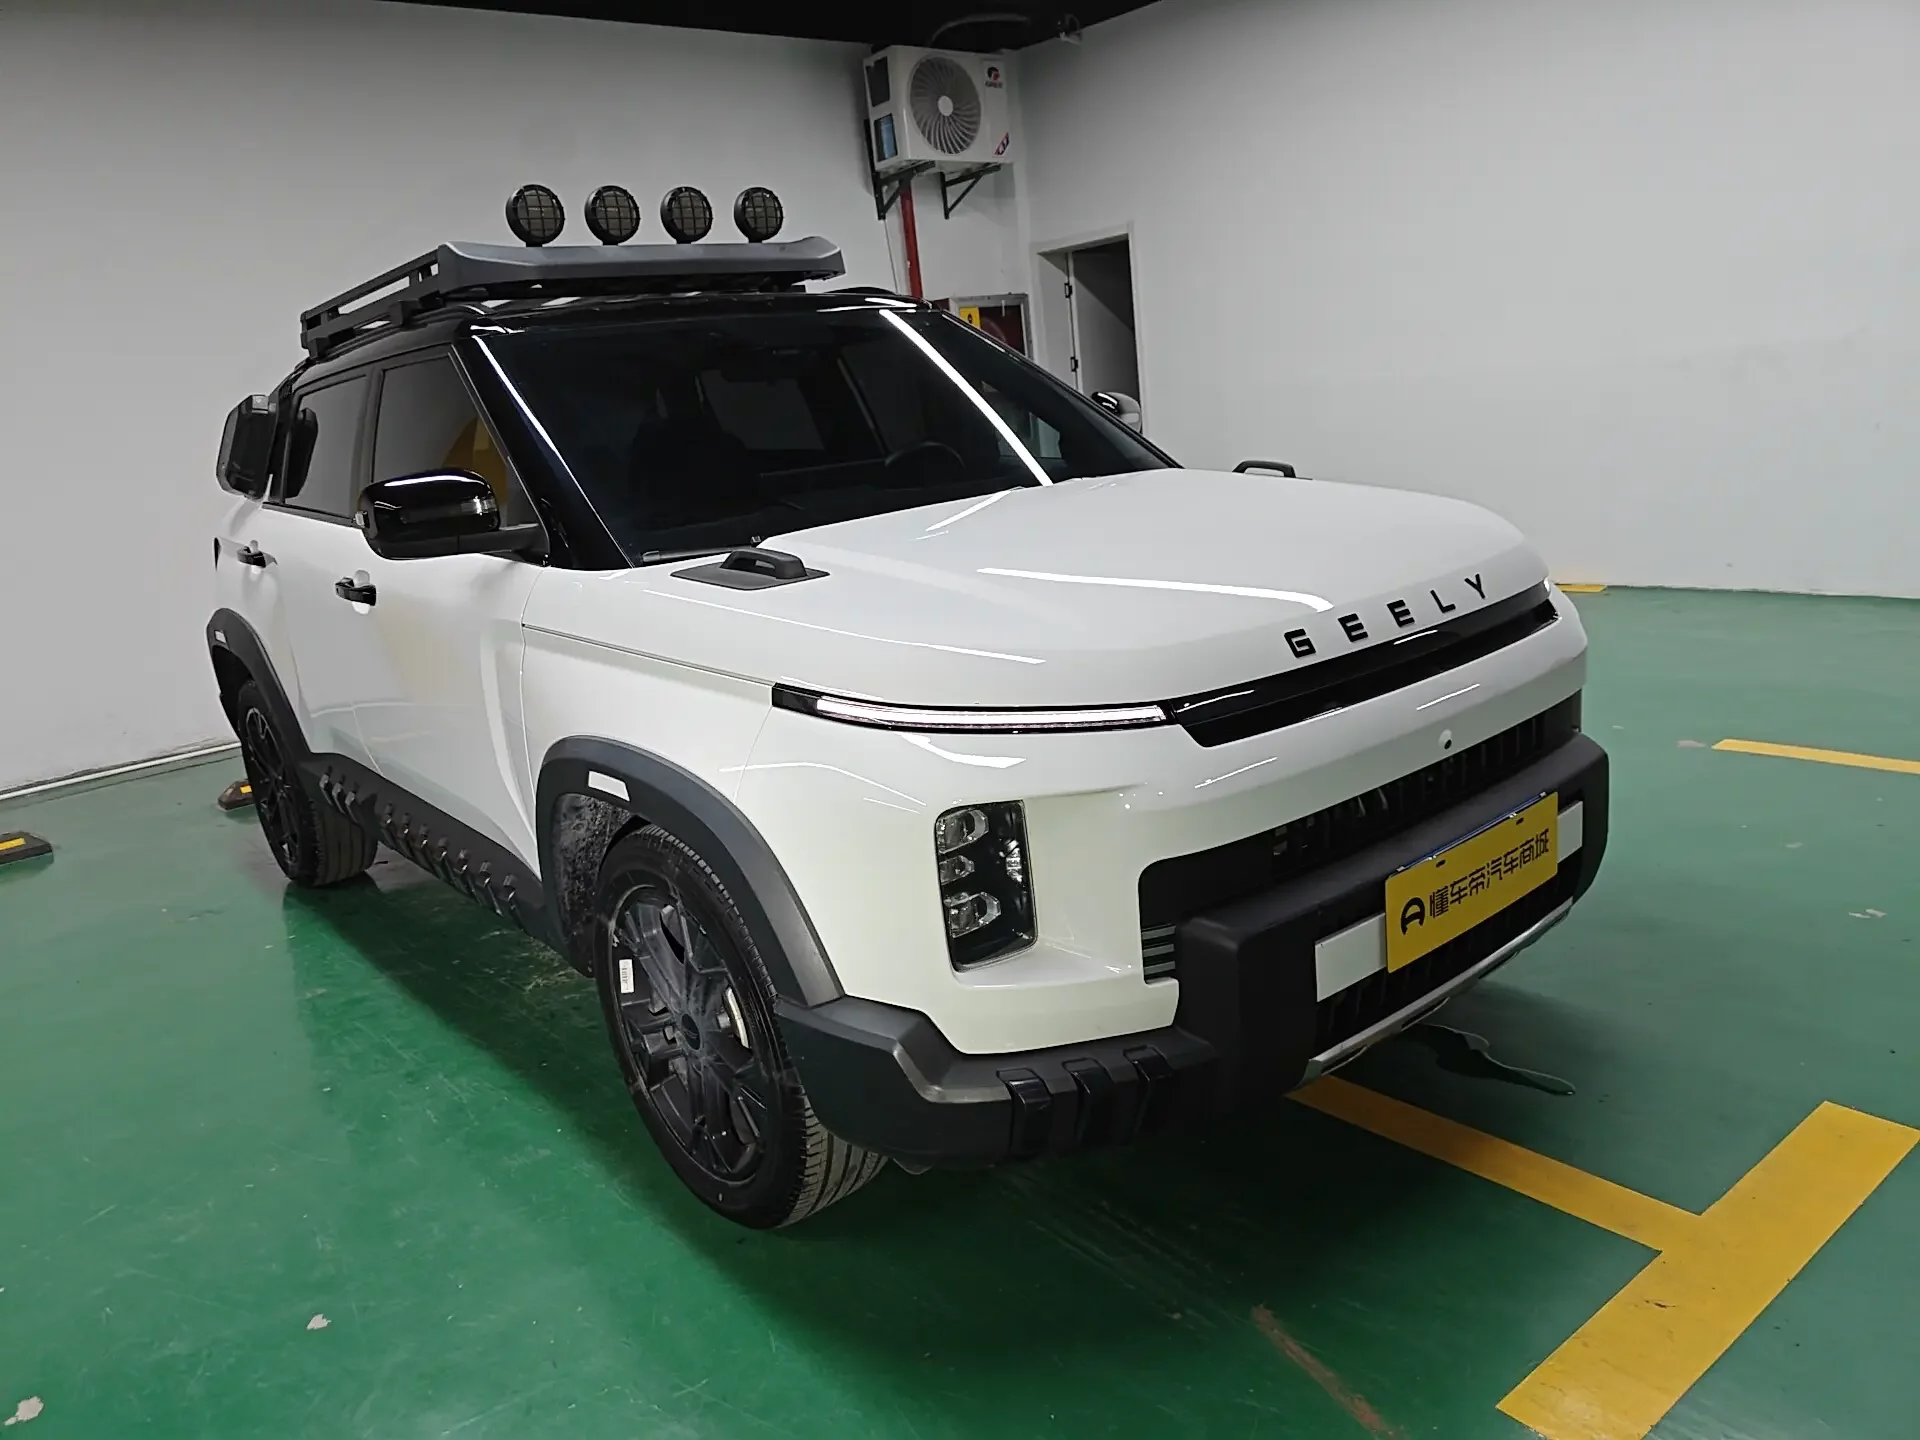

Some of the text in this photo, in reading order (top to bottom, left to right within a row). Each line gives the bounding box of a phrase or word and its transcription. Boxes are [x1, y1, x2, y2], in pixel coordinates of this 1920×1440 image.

[1283, 573, 1486, 658] GEELY
[1429, 828, 1549, 918] 懂车帝汽车商城
